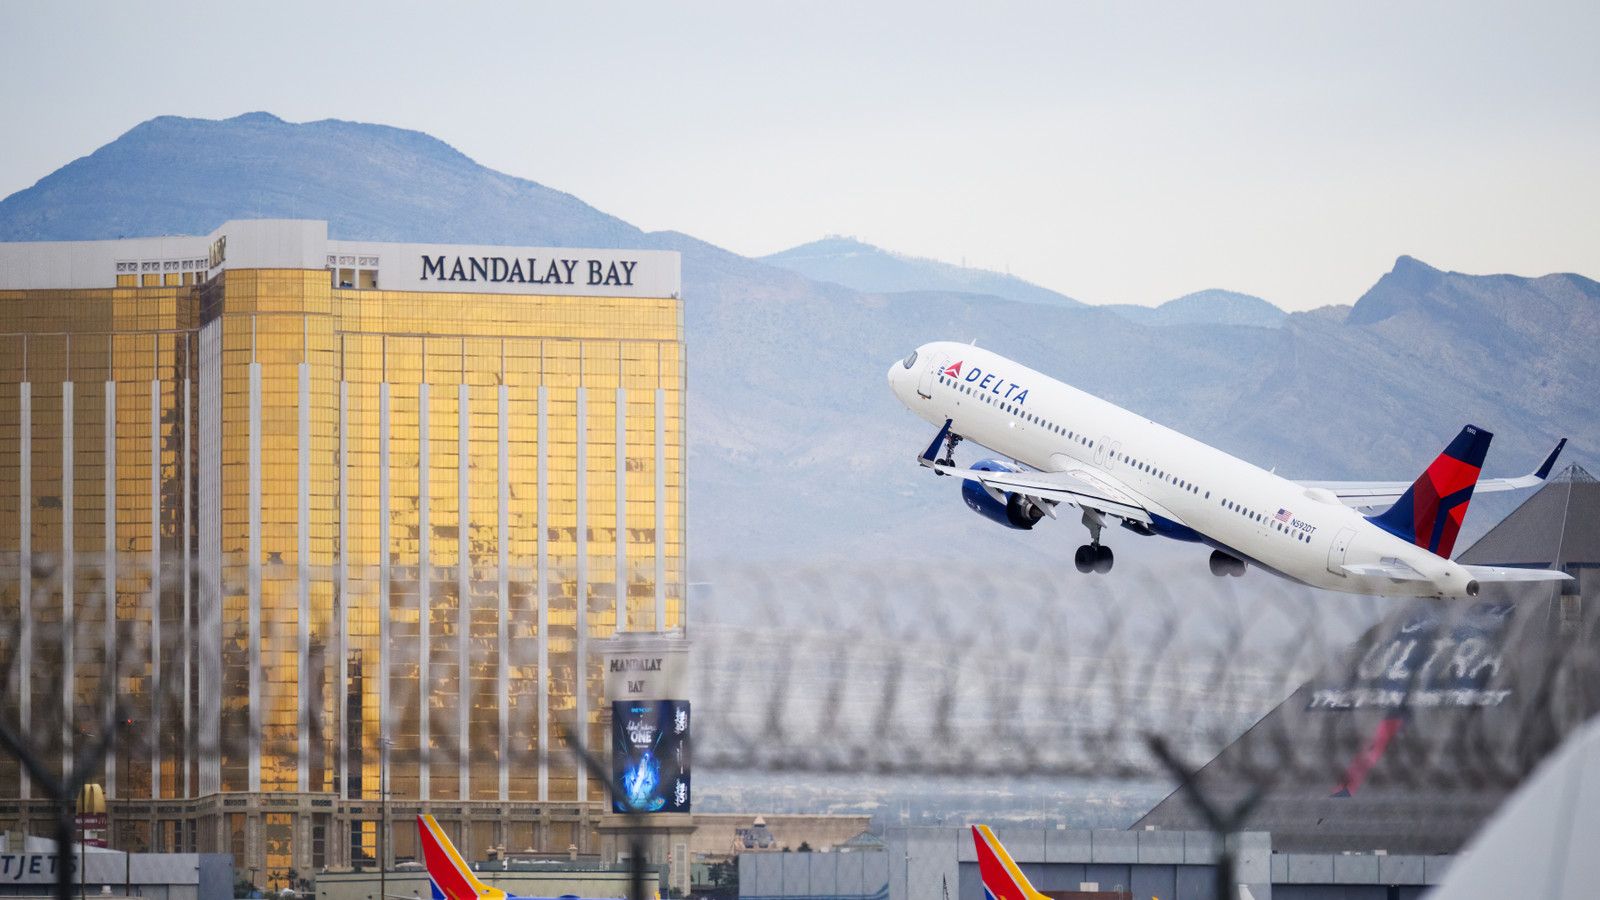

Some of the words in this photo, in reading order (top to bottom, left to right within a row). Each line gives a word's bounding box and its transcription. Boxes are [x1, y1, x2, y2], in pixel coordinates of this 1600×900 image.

[420, 255, 578, 284] MANDALAY
[586, 260, 638, 286] BAY
[965, 367, 1029, 405] DELTA
[1291, 518, 1316, 533] N592DT
[610, 659, 662, 672] MANDALAY
[628, 680, 645, 693] BAY
[630, 730, 652, 743] ONE
